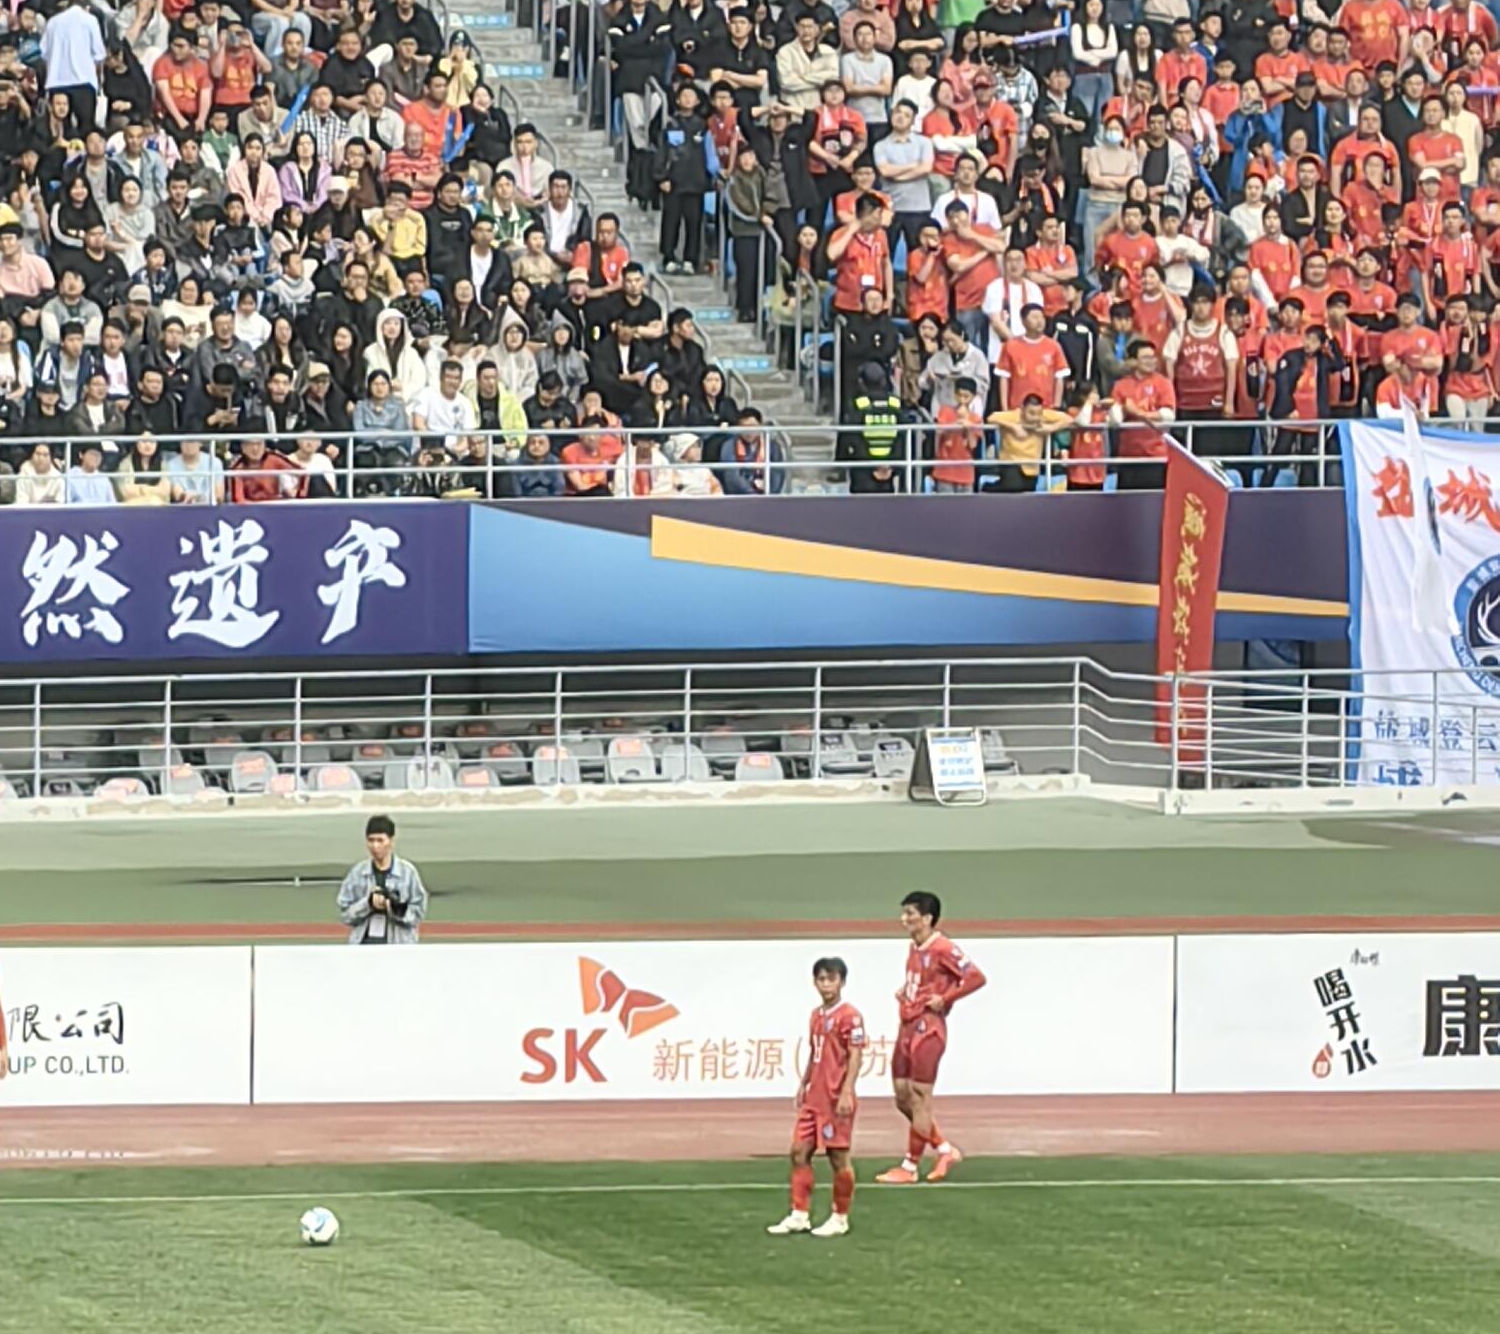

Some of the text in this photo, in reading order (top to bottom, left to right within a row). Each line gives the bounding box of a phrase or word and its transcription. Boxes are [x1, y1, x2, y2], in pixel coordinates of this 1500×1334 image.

[519, 1025, 609, 1085] SK
[1312, 967, 1379, 1076] 喝开水
[1422, 974, 1500, 1057] 康
